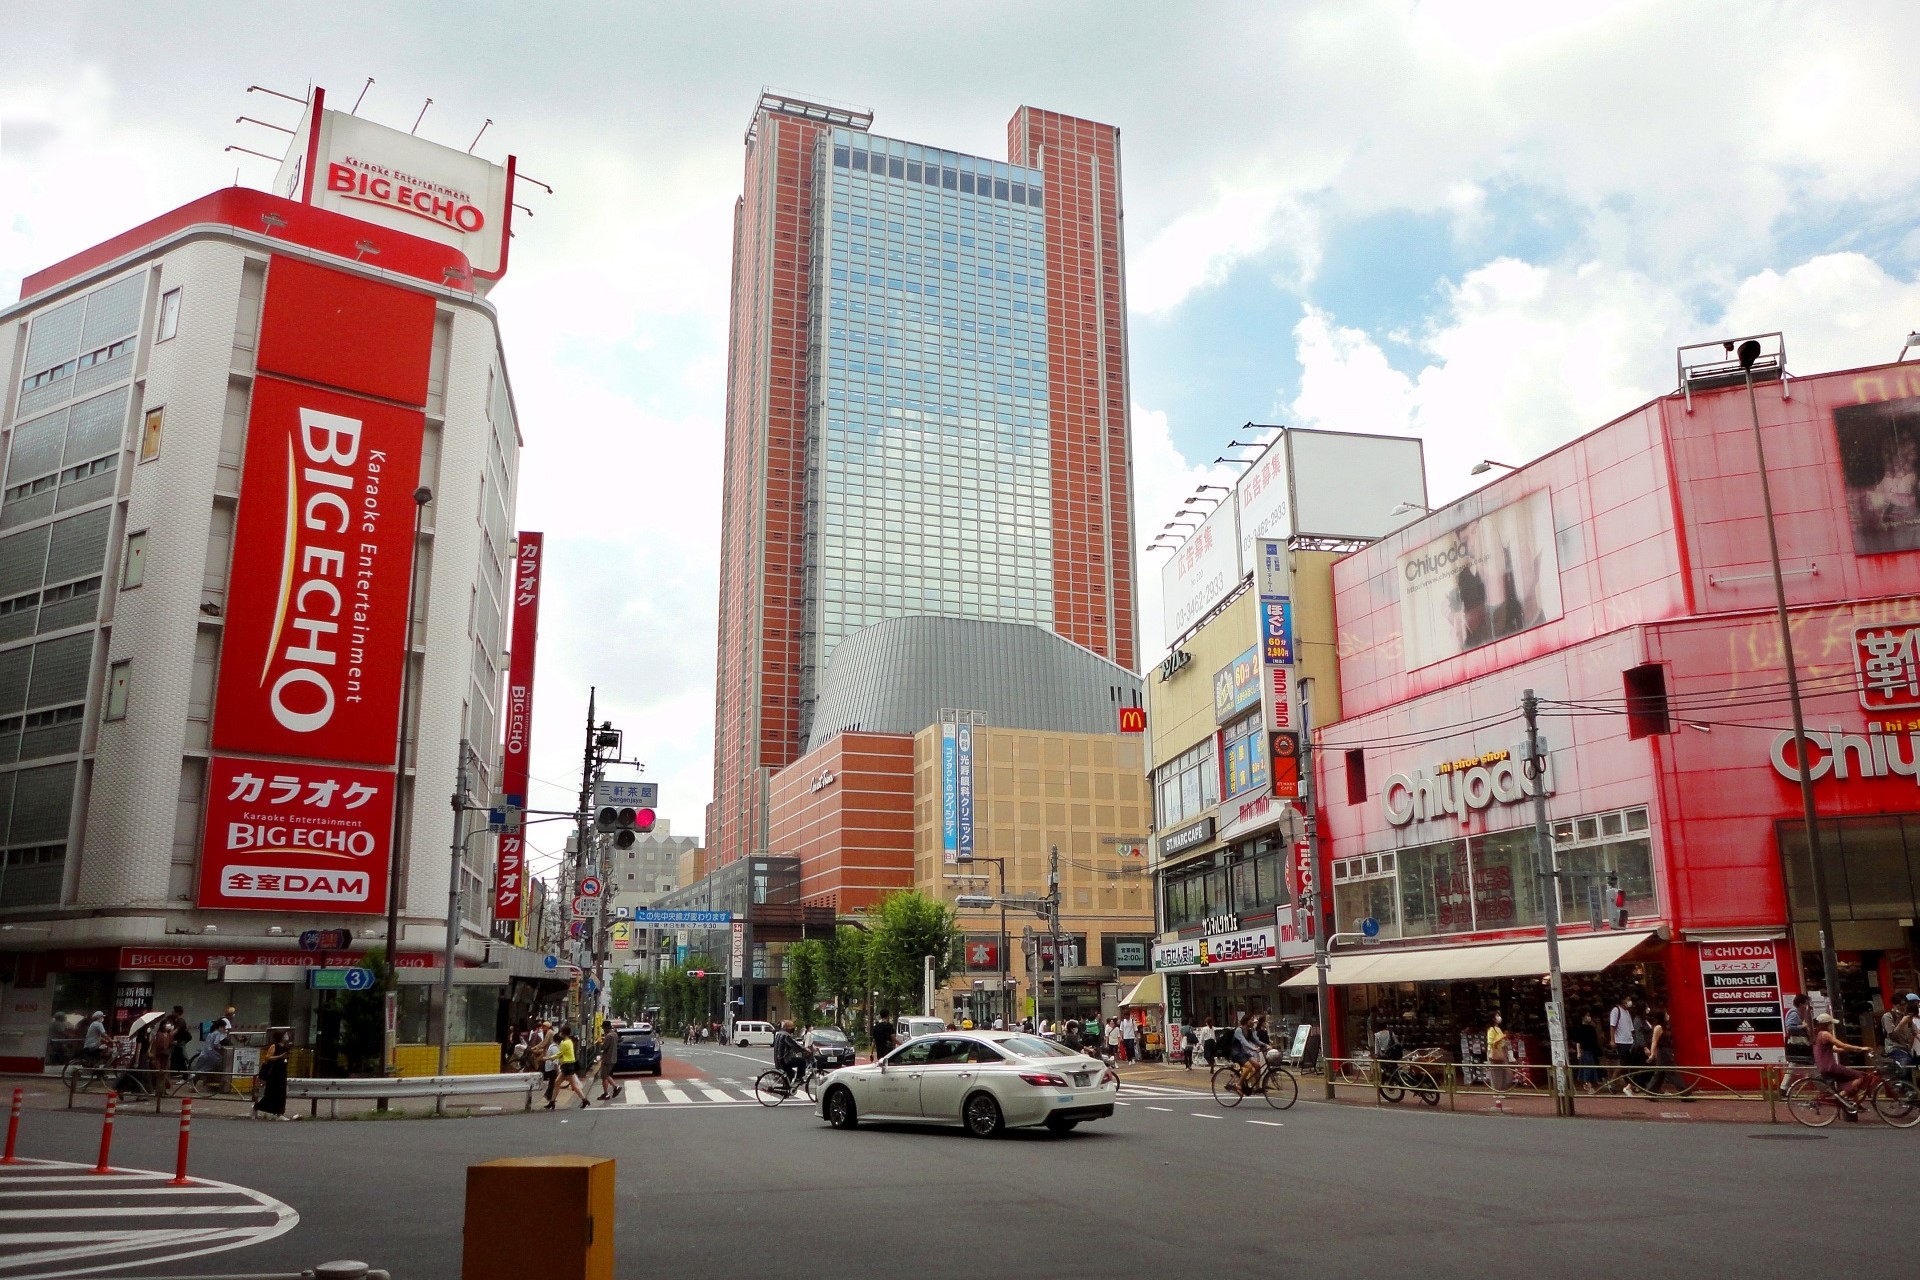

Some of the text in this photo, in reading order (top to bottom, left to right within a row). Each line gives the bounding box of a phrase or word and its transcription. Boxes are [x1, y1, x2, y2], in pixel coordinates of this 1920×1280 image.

[345, 155, 470, 203] Karaoke Entertainment
[327, 162, 391, 200] BIG
[397, 187, 485, 232] ECHO
[1243, 453, 1281, 509] 広告募集
[1177, 525, 1213, 581] 広告募集
[1405, 541, 1469, 581] Chiyoda
[270, 407, 362, 733] BIG ECHO
[346, 449, 387, 704] Karaoke Entertainment
[517, 543, 538, 607] カラオケ
[1176, 571, 1224, 630] 03-3462-2933
[1267, 604, 1285, 636] ほぐし
[1268, 638, 1286, 646] 60分
[1273, 669, 1287, 693] mini
[508, 686, 526, 754] BIG ECHO
[1275, 701, 1289, 728] mini
[1885, 721, 1902, 731] hi
[1440, 750, 1508, 773] hi shoe shop
[227, 772, 378, 810] カラオケ
[600, 785, 652, 798] 三軒茶屋
[608, 796, 643, 805] Sangenjaya
[945, 747, 955, 837] コンタクトのアイシティ
[1382, 745, 1555, 826] Chiyoda
[243, 812, 362, 828] Karaoke Entertainment
[490, 825, 519, 834] 時差式
[227, 822, 375, 857] BIG ECHO
[228, 872, 363, 895] 全室DAM
[499, 838, 520, 907] カラオケ
[1435, 865, 1511, 897] LADIES
[638, 911, 727, 922] この先中央線が変わります
[1439, 896, 1513, 926] SHOES
[131, 954, 194, 966] BIG ECHO
[257, 956, 314, 967] BIG ECHO
[733, 932, 742, 967] TOKYU
[972, 944, 990, 963] 本
[1715, 946, 1772, 956] CHIYODA
[350, 972, 361, 986] 3
[1714, 975, 1767, 986] HYDRO-TECH
